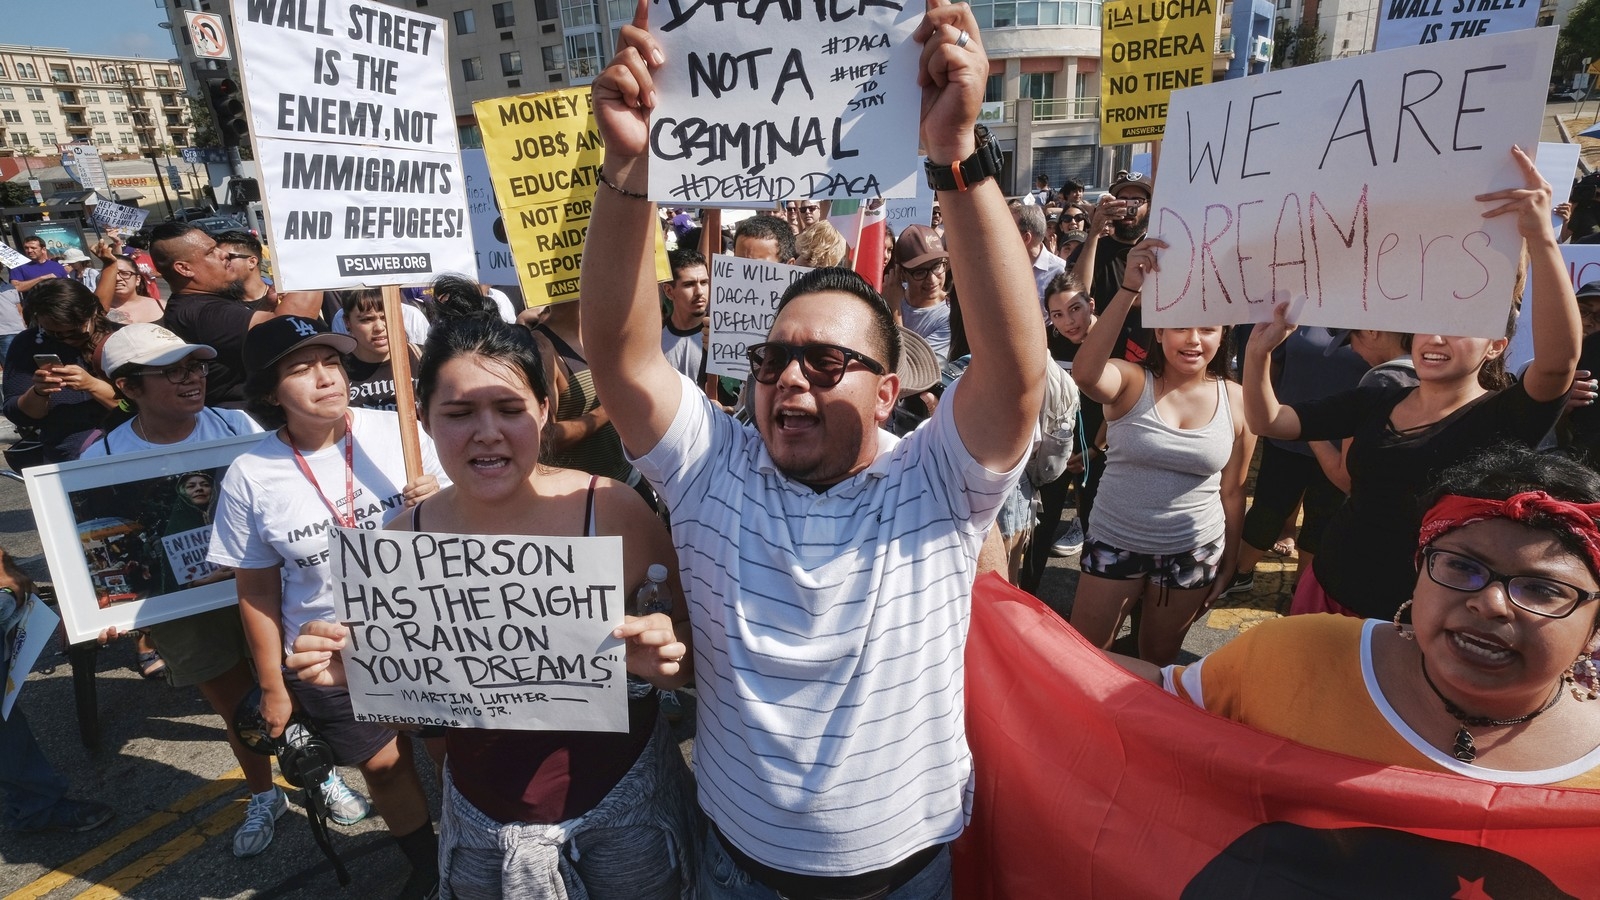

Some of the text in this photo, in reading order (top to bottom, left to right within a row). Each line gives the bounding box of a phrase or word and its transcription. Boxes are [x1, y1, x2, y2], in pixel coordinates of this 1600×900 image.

[1137, 0, 1212, 24] LUCHA
[1387, 0, 1443, 20] WALL
[247, 0, 437, 56] WALL STREET
[1418, 18, 1492, 45] IS THE
[821, 33, 891, 54] #DACA
[1111, 32, 1205, 63] OBRERA
[314, 47, 399, 95] IS THE
[687, 47, 814, 105] NOT A
[1109, 67, 1204, 95] NO TIENE
[855, 80, 878, 93] TO
[498, 94, 579, 127] MONEY
[847, 92, 887, 111] STAY
[1106, 103, 1168, 123] FRONTE
[1126, 126, 1166, 136] ANSWER-LA
[1186, 63, 1507, 185] WE ARE
[511, 129, 605, 162] JOB$ AN
[650, 115, 860, 176] CRIMINAL
[282, 152, 452, 195] IMMIGRANTS
[509, 164, 600, 197] EDUCATI
[669, 171, 882, 202] #DEFEND DACA
[95, 207, 119, 218] STARS
[98, 200, 113, 208] HEY
[519, 200, 592, 229] NOT FOR
[112, 219, 142, 228] FAMILIES
[284, 206, 464, 240] AND REFUGEES!
[1155, 183, 1492, 313] DREAMers
[344, 256, 427, 272] PSLWEB.ORG
[714, 260, 734, 278] WE
[743, 264, 783, 283] WILL
[713, 310, 776, 332] DEFEND
[712, 341, 748, 361] PAR
[336, 489, 362, 507] ANER
[287, 493, 406, 544] IMMRANT
[294, 550, 330, 569] REF
[412, 534, 576, 580] PERSON
[341, 582, 617, 624] HAS THE RIGHT
[340, 621, 550, 652] TO RAIN ON
[351, 655, 451, 685] YOUR
[400, 689, 550, 705] MARTIN LUTHER
[488, 705, 513, 717] JR.
